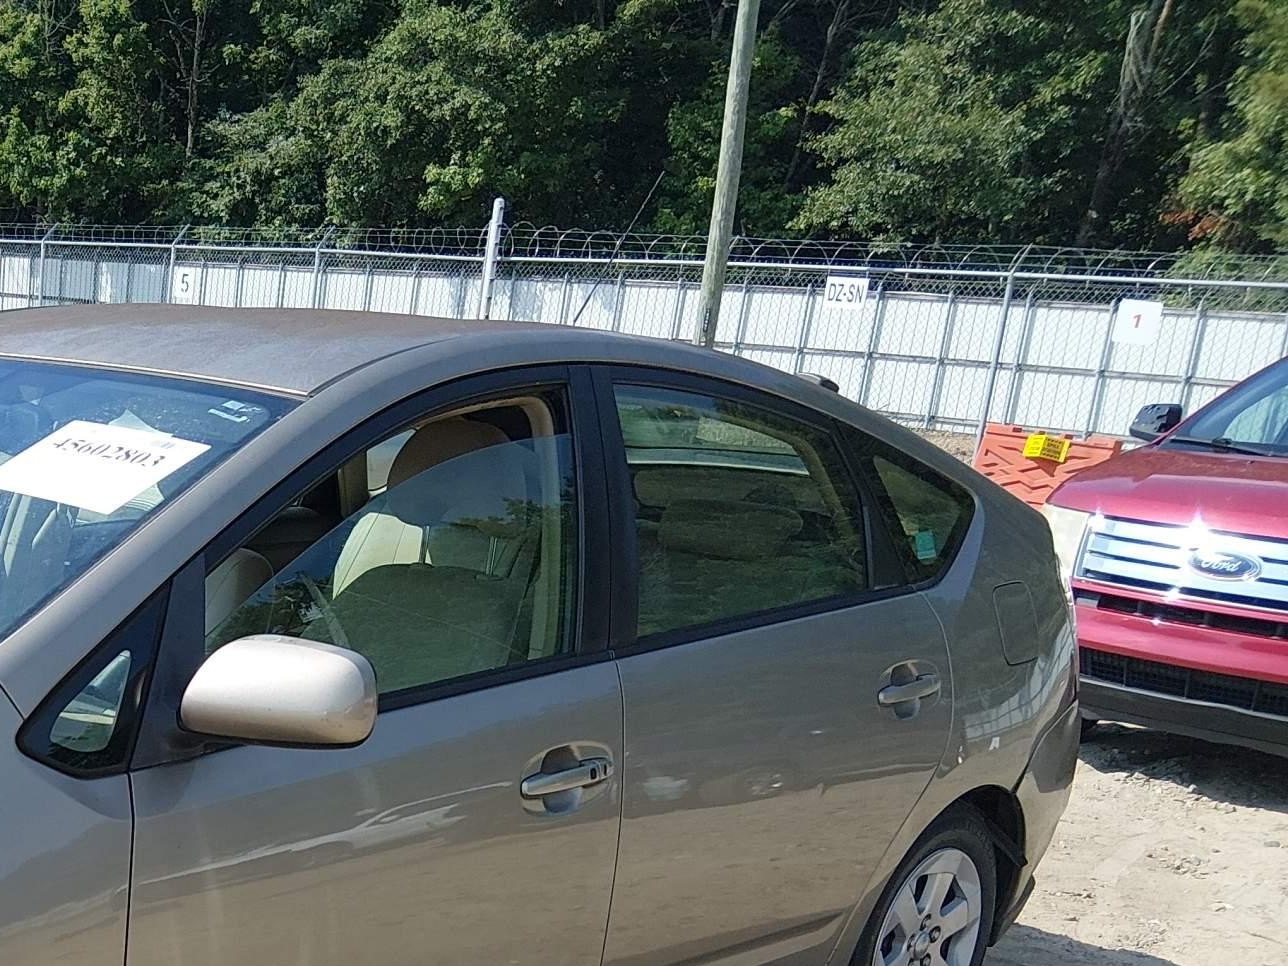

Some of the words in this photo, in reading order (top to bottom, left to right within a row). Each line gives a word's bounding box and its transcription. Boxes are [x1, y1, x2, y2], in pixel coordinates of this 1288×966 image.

[181, 273, 189, 293] 5
[1133, 314, 1142, 328] 1
[52, 438, 167, 467] 45602803
[1200, 558, 1243, 573] Ford
